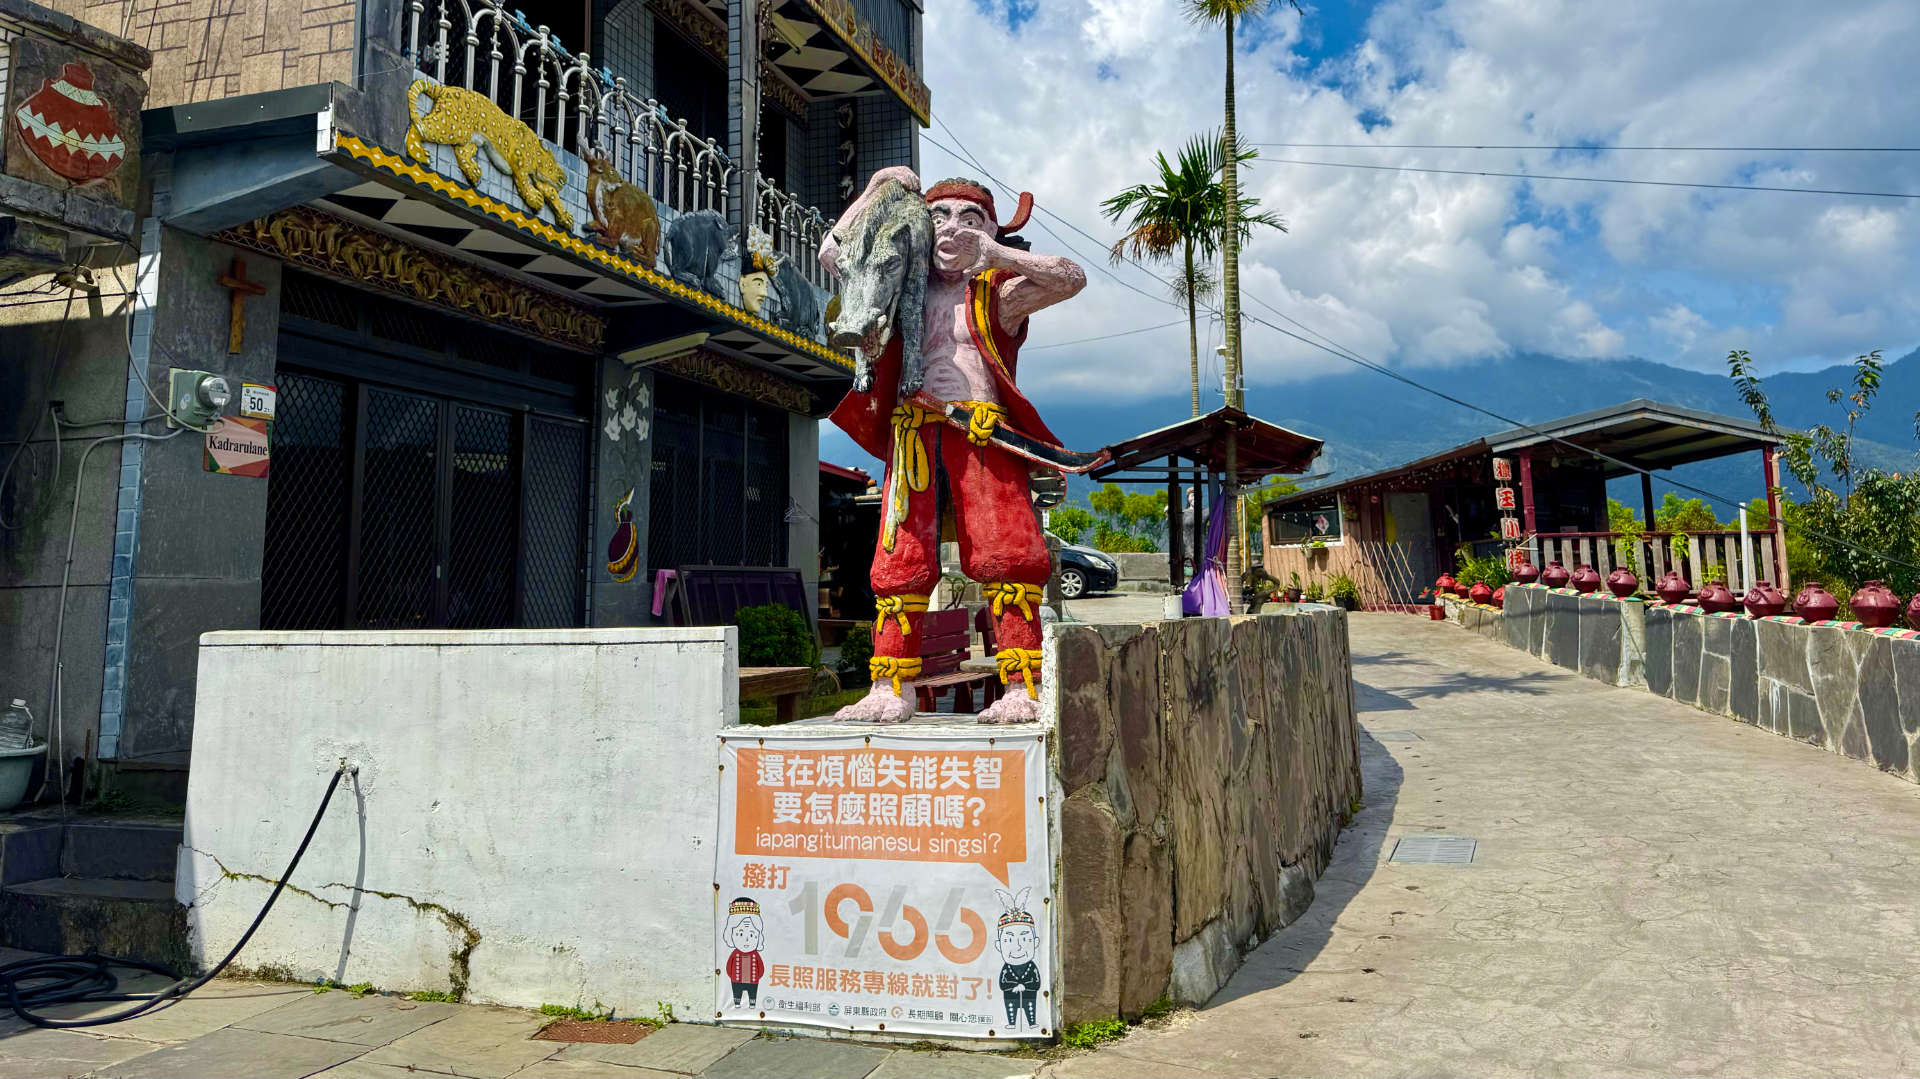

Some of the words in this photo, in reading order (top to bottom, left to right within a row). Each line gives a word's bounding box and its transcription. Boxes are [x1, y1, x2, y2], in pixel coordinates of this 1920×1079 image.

[250, 397, 263, 411] 50
[209, 435, 268, 456] Kadrarulane
[756, 753, 1002, 790] 還在煩惱失能失智
[772, 791, 986, 829] 要怎麼照顧嗎?
[928, 831, 1002, 857] singsi?
[742, 863, 791, 890] 撥打
[788, 881, 988, 965] 1966
[769, 964, 993, 1001] 長照服務專線就對了!
[844, 1006, 887, 1017] 屏東縣政府
